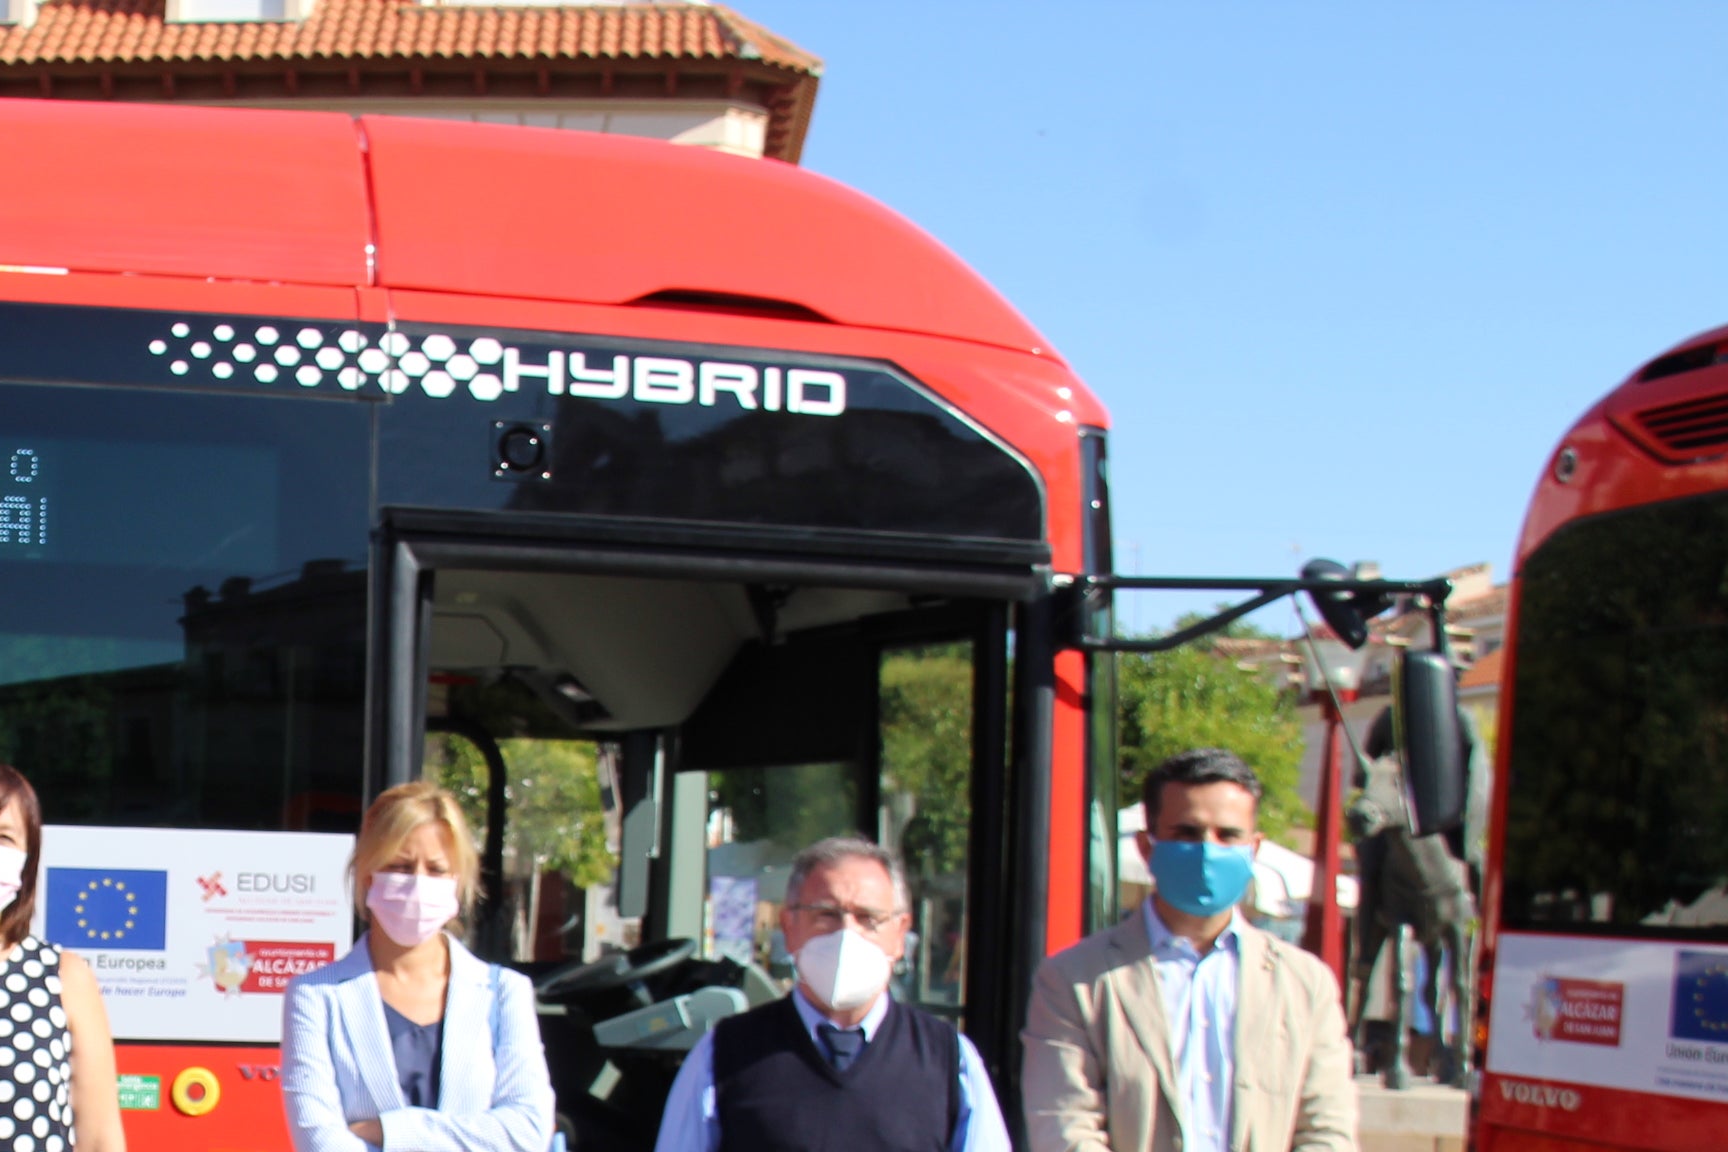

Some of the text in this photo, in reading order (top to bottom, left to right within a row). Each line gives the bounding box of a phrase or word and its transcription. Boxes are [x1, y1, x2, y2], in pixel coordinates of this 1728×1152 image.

[502, 347, 847, 417] HYBRID
[236, 872, 316, 894] EDUSI
[95, 953, 167, 972] Europea
[1498, 1079, 1582, 1113] VOLVO
